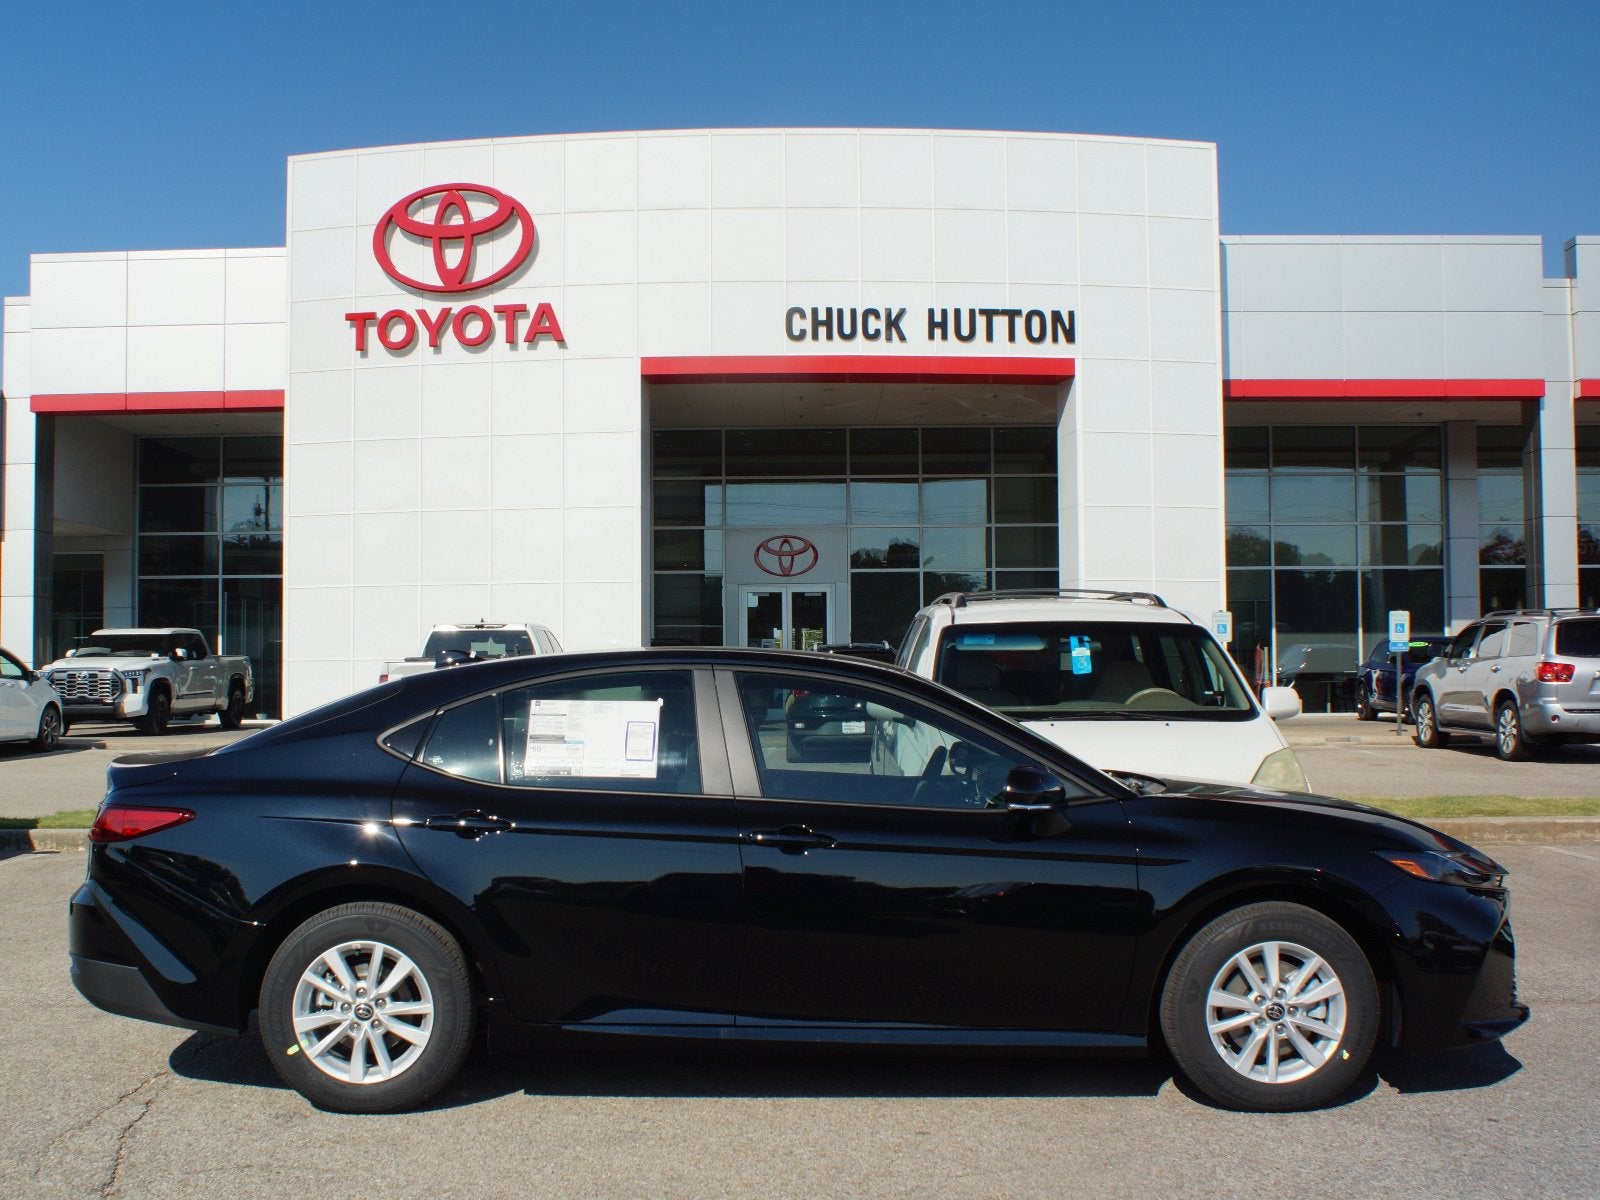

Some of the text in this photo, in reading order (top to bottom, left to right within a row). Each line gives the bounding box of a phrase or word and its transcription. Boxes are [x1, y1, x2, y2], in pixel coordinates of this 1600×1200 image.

[345, 302, 566, 352] TOYOTA
[786, 307, 1076, 345] CHUCK HUTTON
